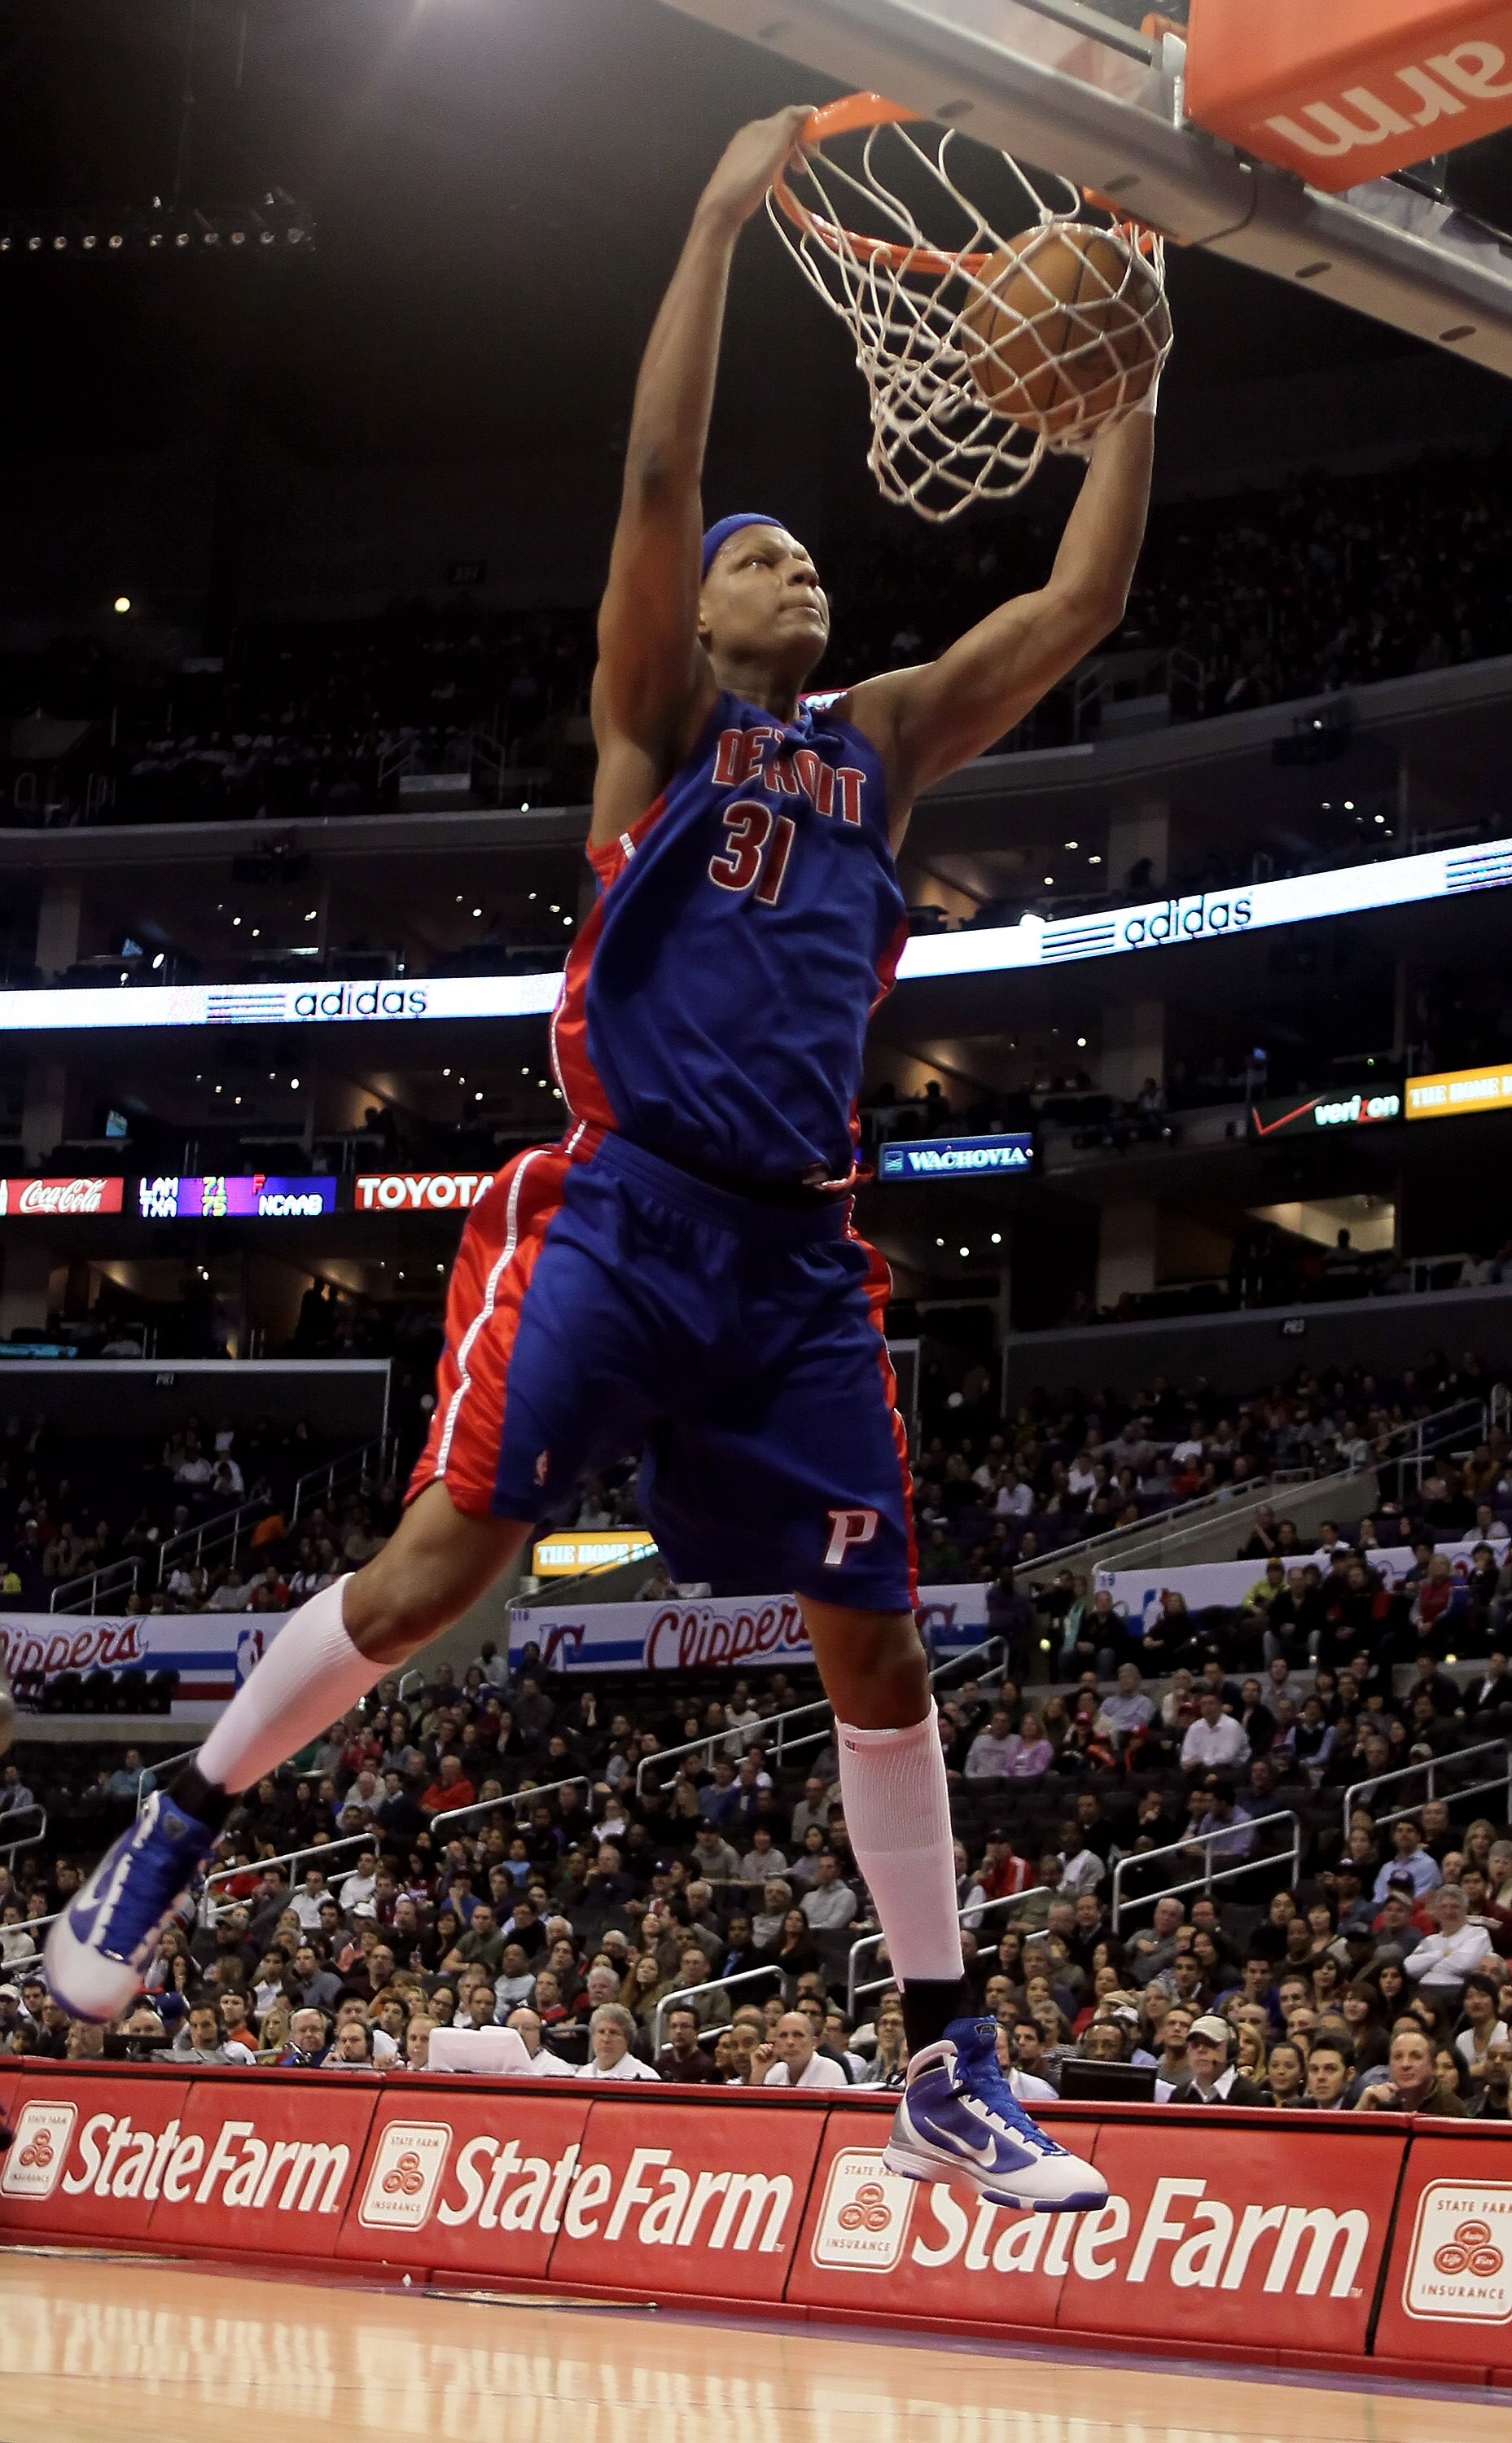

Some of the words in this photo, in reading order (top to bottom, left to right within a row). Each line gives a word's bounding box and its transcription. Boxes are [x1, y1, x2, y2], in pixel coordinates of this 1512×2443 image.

[708, 800, 795, 906] 31
[1124, 894, 1253, 945] adidas
[296, 982, 427, 1016] adidas
[1409, 1085, 1447, 1108] THE
[1448, 1077, 1500, 1102] HOME
[1314, 1094, 1400, 1125] verizon
[907, 1147, 1028, 1172] WACHOVIA
[140, 1177, 178, 1198] LAM
[202, 1176, 226, 1197] 71
[140, 1196, 177, 1217] TXA
[202, 1195, 227, 1217] 75
[259, 1194, 323, 1217] NCAAB
[823, 1510, 879, 1564] P
[537, 1545, 576, 1565] THE
[390, 2136, 414, 2147] STATE
[415, 2137, 439, 2147] FARM
[844, 2164, 874, 2176] STATE
[1437, 2200, 1475, 2213] STATE
[826, 2238, 892, 2252] INSURANCE
[1420, 2283, 1505, 2300] INSURANCE
